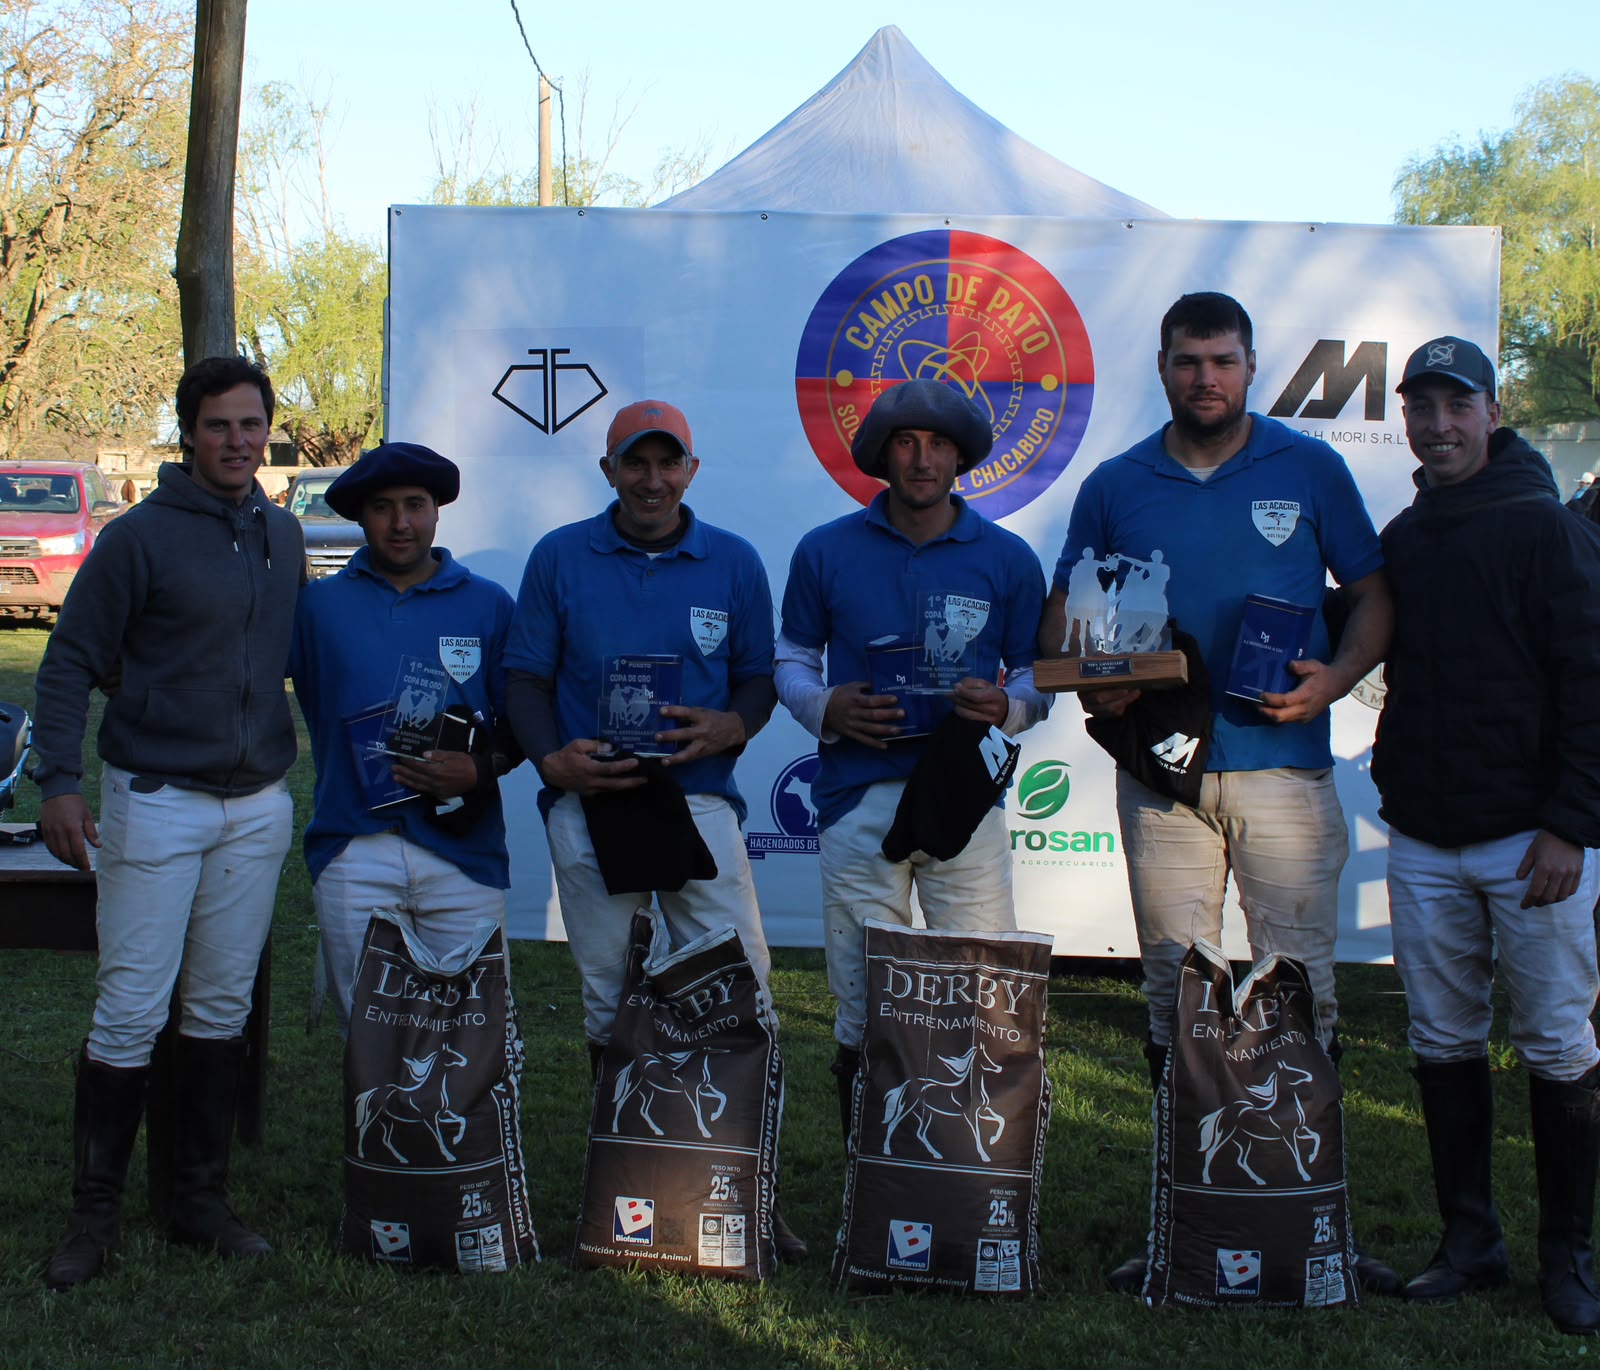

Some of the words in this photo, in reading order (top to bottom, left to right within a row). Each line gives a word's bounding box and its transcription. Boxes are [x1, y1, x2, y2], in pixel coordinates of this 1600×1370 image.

[845, 274, 934, 350] CAMPO
[946, 272, 983, 306] DE
[986, 286, 1050, 354] PATO
[1331, 431, 1366, 443] MORI
[1370, 432, 1407, 445] S.R.L.
[969, 406, 1055, 489] CHACABUCO
[1254, 502, 1268, 510] LAS
[1269, 502, 1299, 512] ACACIAS
[948, 597, 960, 606] LAS
[962, 598, 990, 612] ACACIAS
[692, 609, 705, 618] LAS
[924, 610, 943, 619] COPA
[441, 638, 454, 647] LAS
[403, 674, 420, 686] COPA
[420, 679, 428, 688] DE
[429, 681, 442, 690] ORO
[609, 673, 627, 683] COPA
[628, 674, 637, 682] DE
[750, 837, 805, 850] HACENDADOS
[807, 839, 818, 850] DE
[1021, 859, 1114, 868] AGROPECUARIOS
[373, 961, 487, 1006] DERBY
[883, 963, 1031, 1016] DERBY
[880, 1002, 1021, 1042] ENTRENAMIENTO
[1159, 1086, 1170, 1165] Sanidad
[762, 1095, 777, 1174] Sanidad
[501, 1096, 520, 1173] Sanidad
[511, 1178, 530, 1239] Animal
[710, 1164, 726, 1172] PESO
[726, 1165, 741, 1173] NETO
[1160, 1168, 1171, 1183] y
[459, 1183, 475, 1191] PESO
[475, 1180, 491, 1190] NETO
[710, 1176, 730, 1201] 25
[729, 1185, 739, 1202] Kg
[989, 1188, 1005, 1196] PESO
[1005, 1189, 1018, 1197] NETO
[461, 1192, 483, 1219] 25
[483, 1201, 492, 1214] Kg
[760, 1174, 771, 1240] Animal
[988, 1200, 1008, 1226] 25
[1154, 1189, 1169, 1272] Nutrición
[1313, 1215, 1330, 1244] 25
[615, 1234, 651, 1245] Biofarma
[578, 1242, 615, 1256] Nutrición
[616, 1250, 623, 1258] y
[624, 1248, 658, 1260] Sanidad
[660, 1252, 692, 1263] Animal
[889, 1258, 927, 1270] Biofarma
[848, 1265, 887, 1281] Nutrición
[889, 1274, 895, 1282] y
[897, 1273, 934, 1284] Sanidad
[936, 1277, 969, 1287] Animal
[1218, 1286, 1257, 1296] Biofarma
[1173, 1291, 1216, 1308] Nutrición
